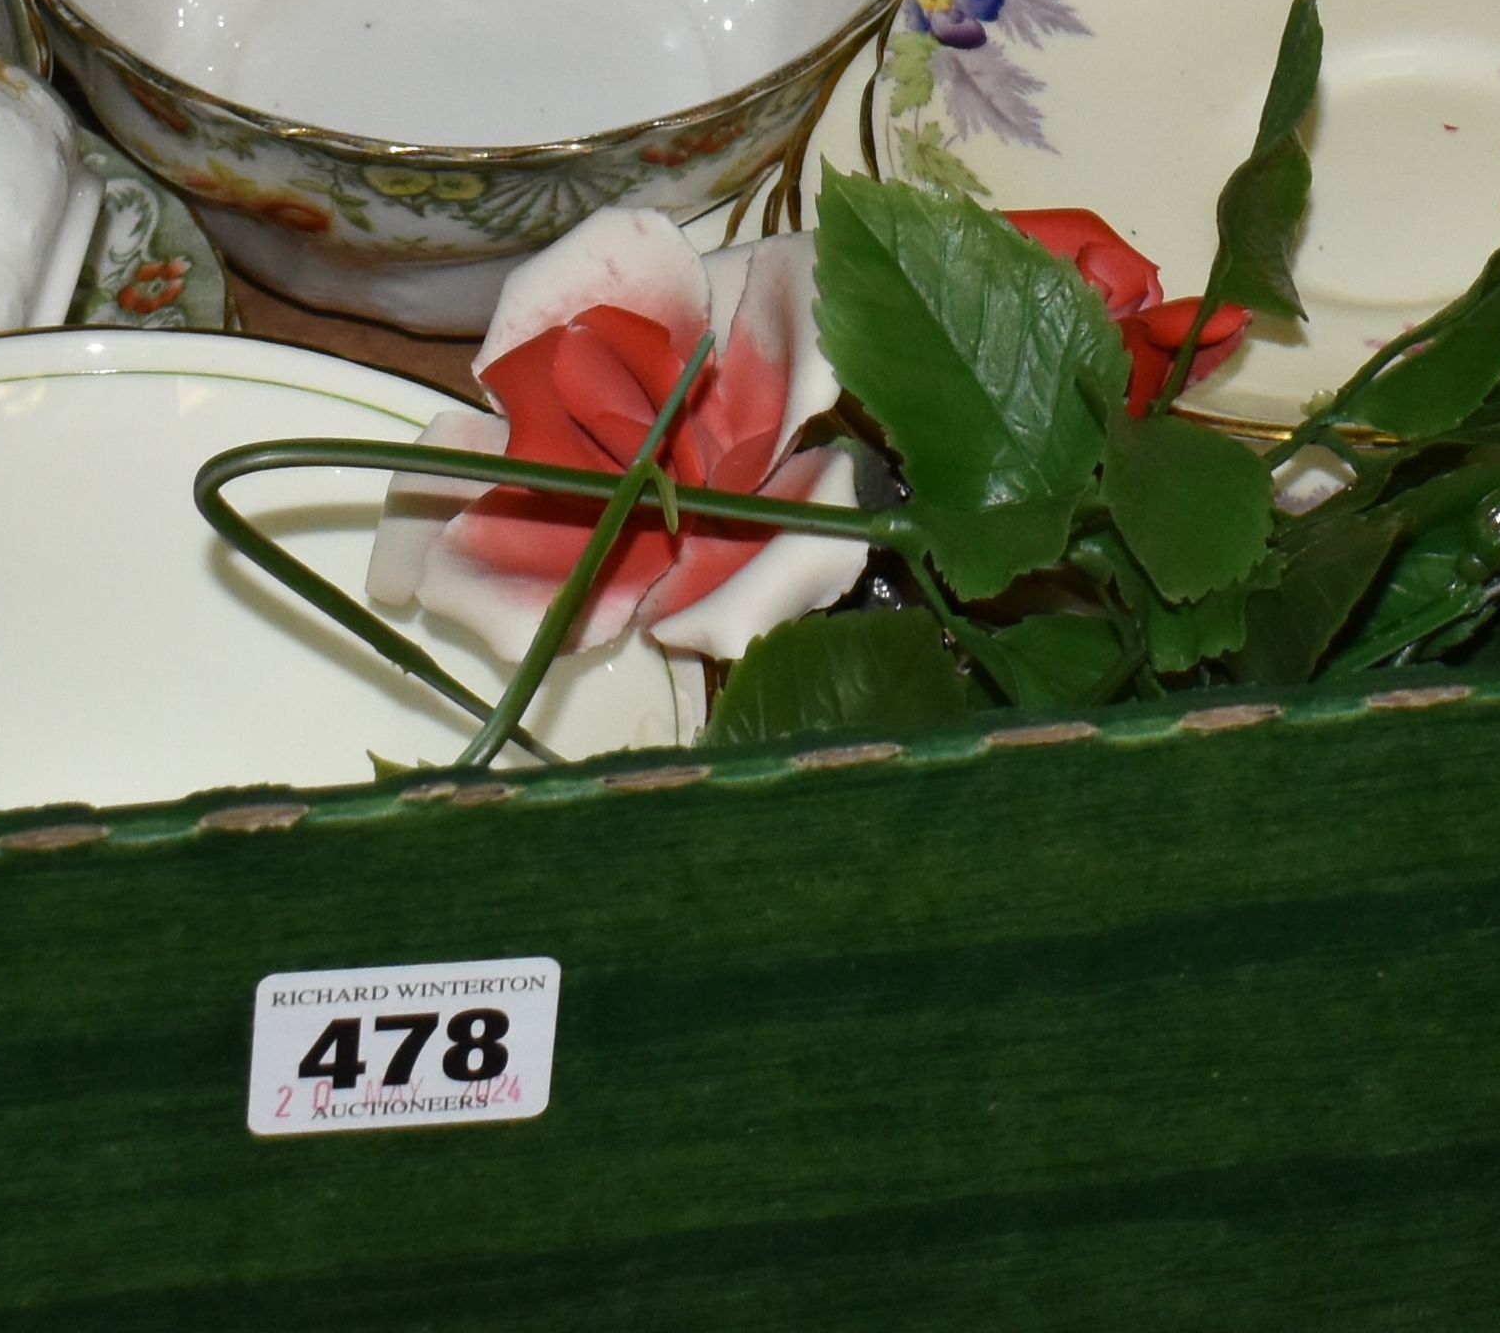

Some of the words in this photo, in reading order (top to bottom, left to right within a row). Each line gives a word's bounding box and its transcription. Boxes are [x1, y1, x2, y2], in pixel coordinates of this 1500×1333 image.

[271, 984, 389, 1008] RICHARD
[398, 974, 547, 999] WINTERTON
[297, 1007, 510, 1090] 478
[312, 1094, 489, 1121] AUCTIONEERS
[364, 1076, 423, 1108] MAY
[461, 1072, 523, 1110] 2024
